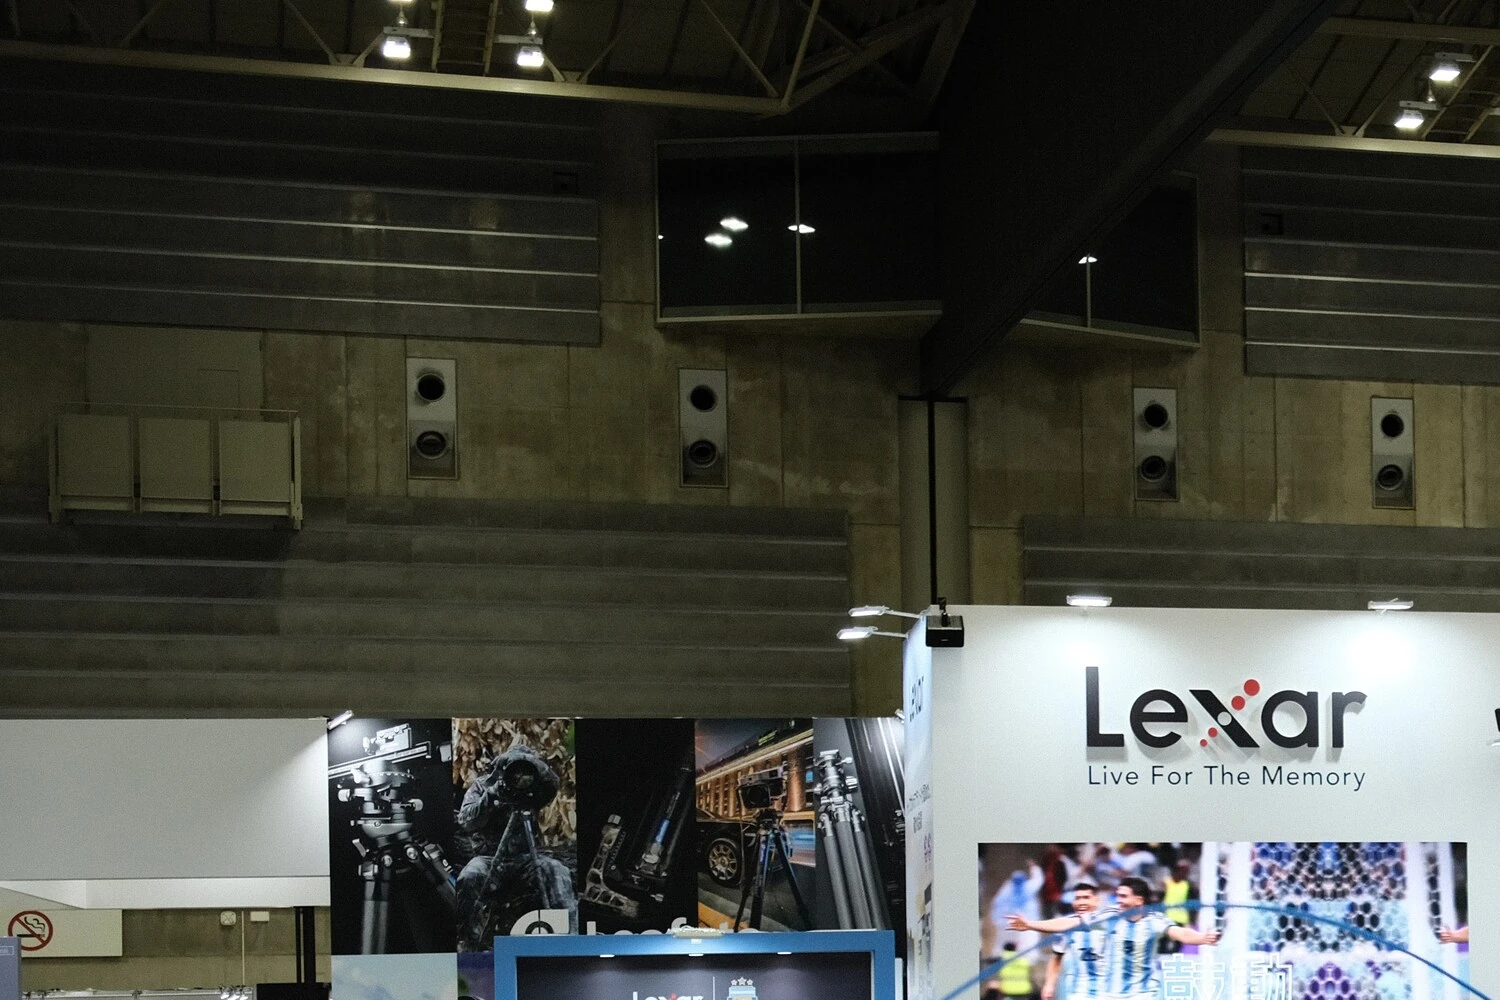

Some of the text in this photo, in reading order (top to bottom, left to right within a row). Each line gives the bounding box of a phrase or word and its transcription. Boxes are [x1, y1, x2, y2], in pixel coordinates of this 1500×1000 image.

[1085, 666, 1368, 749] Lexar
[1088, 764, 1366, 792] Live For The Memory
